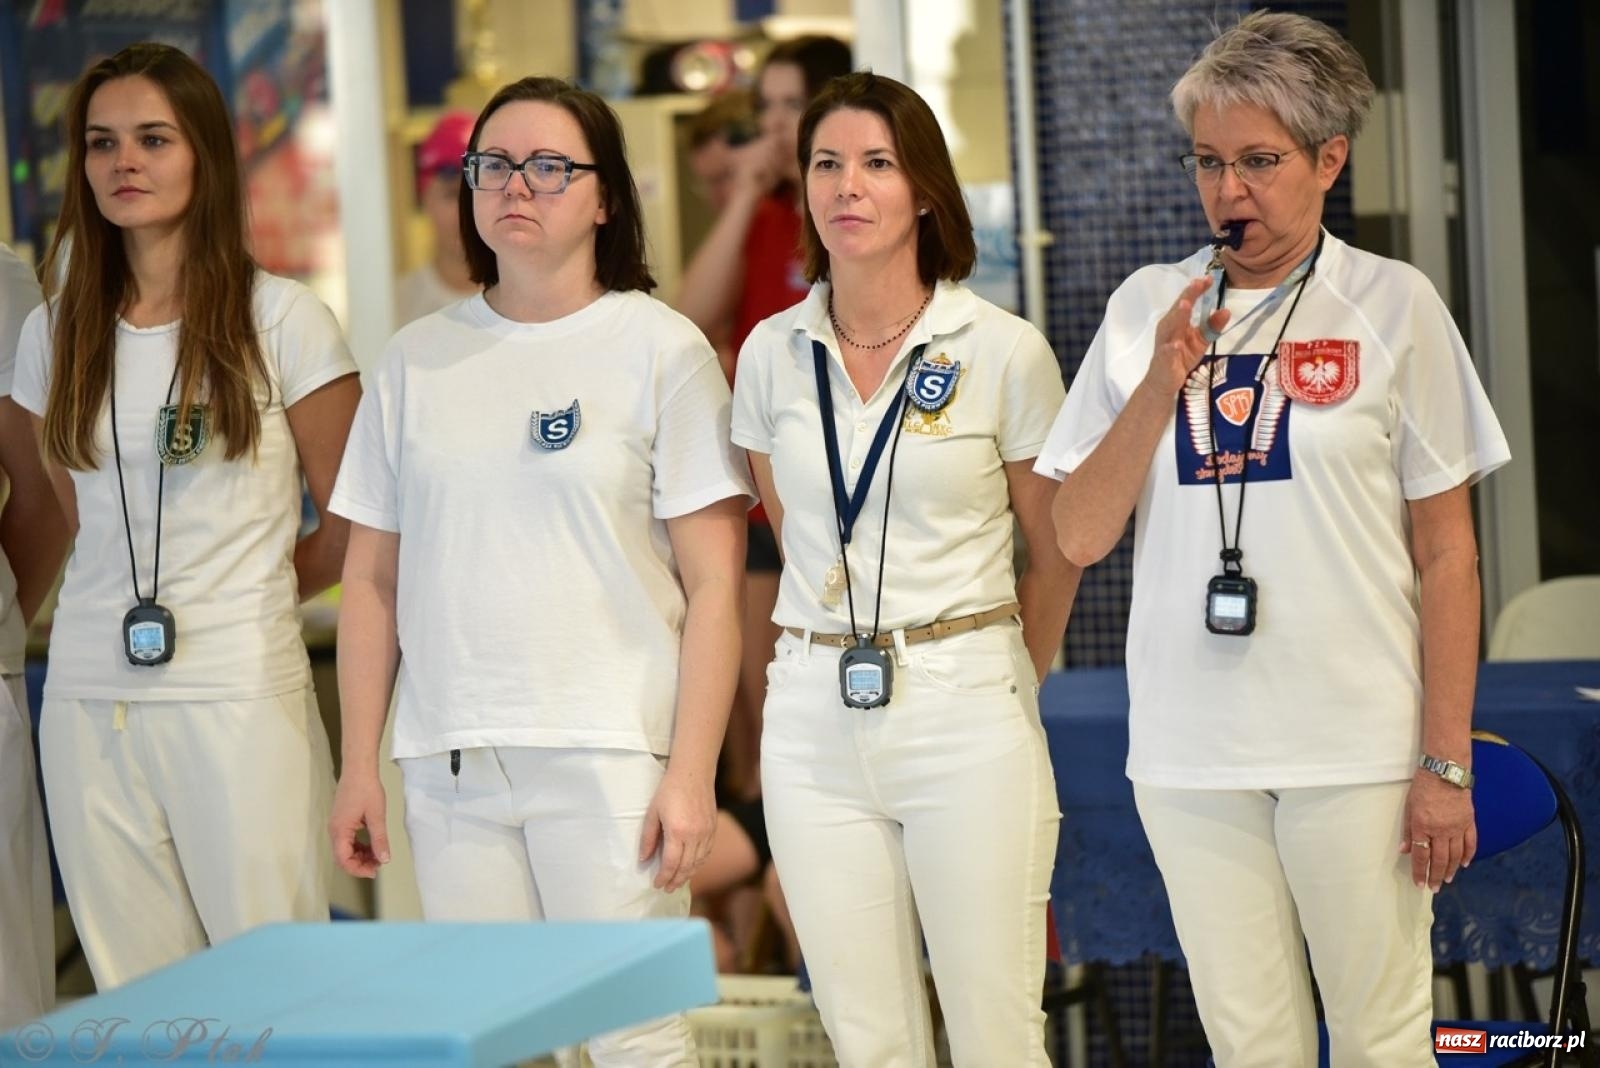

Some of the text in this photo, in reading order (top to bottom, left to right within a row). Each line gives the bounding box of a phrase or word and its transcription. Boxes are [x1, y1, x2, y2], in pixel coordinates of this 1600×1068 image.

[919, 375, 946, 400] S
[1223, 394, 1251, 418] SP15
[547, 418, 568, 440] S
